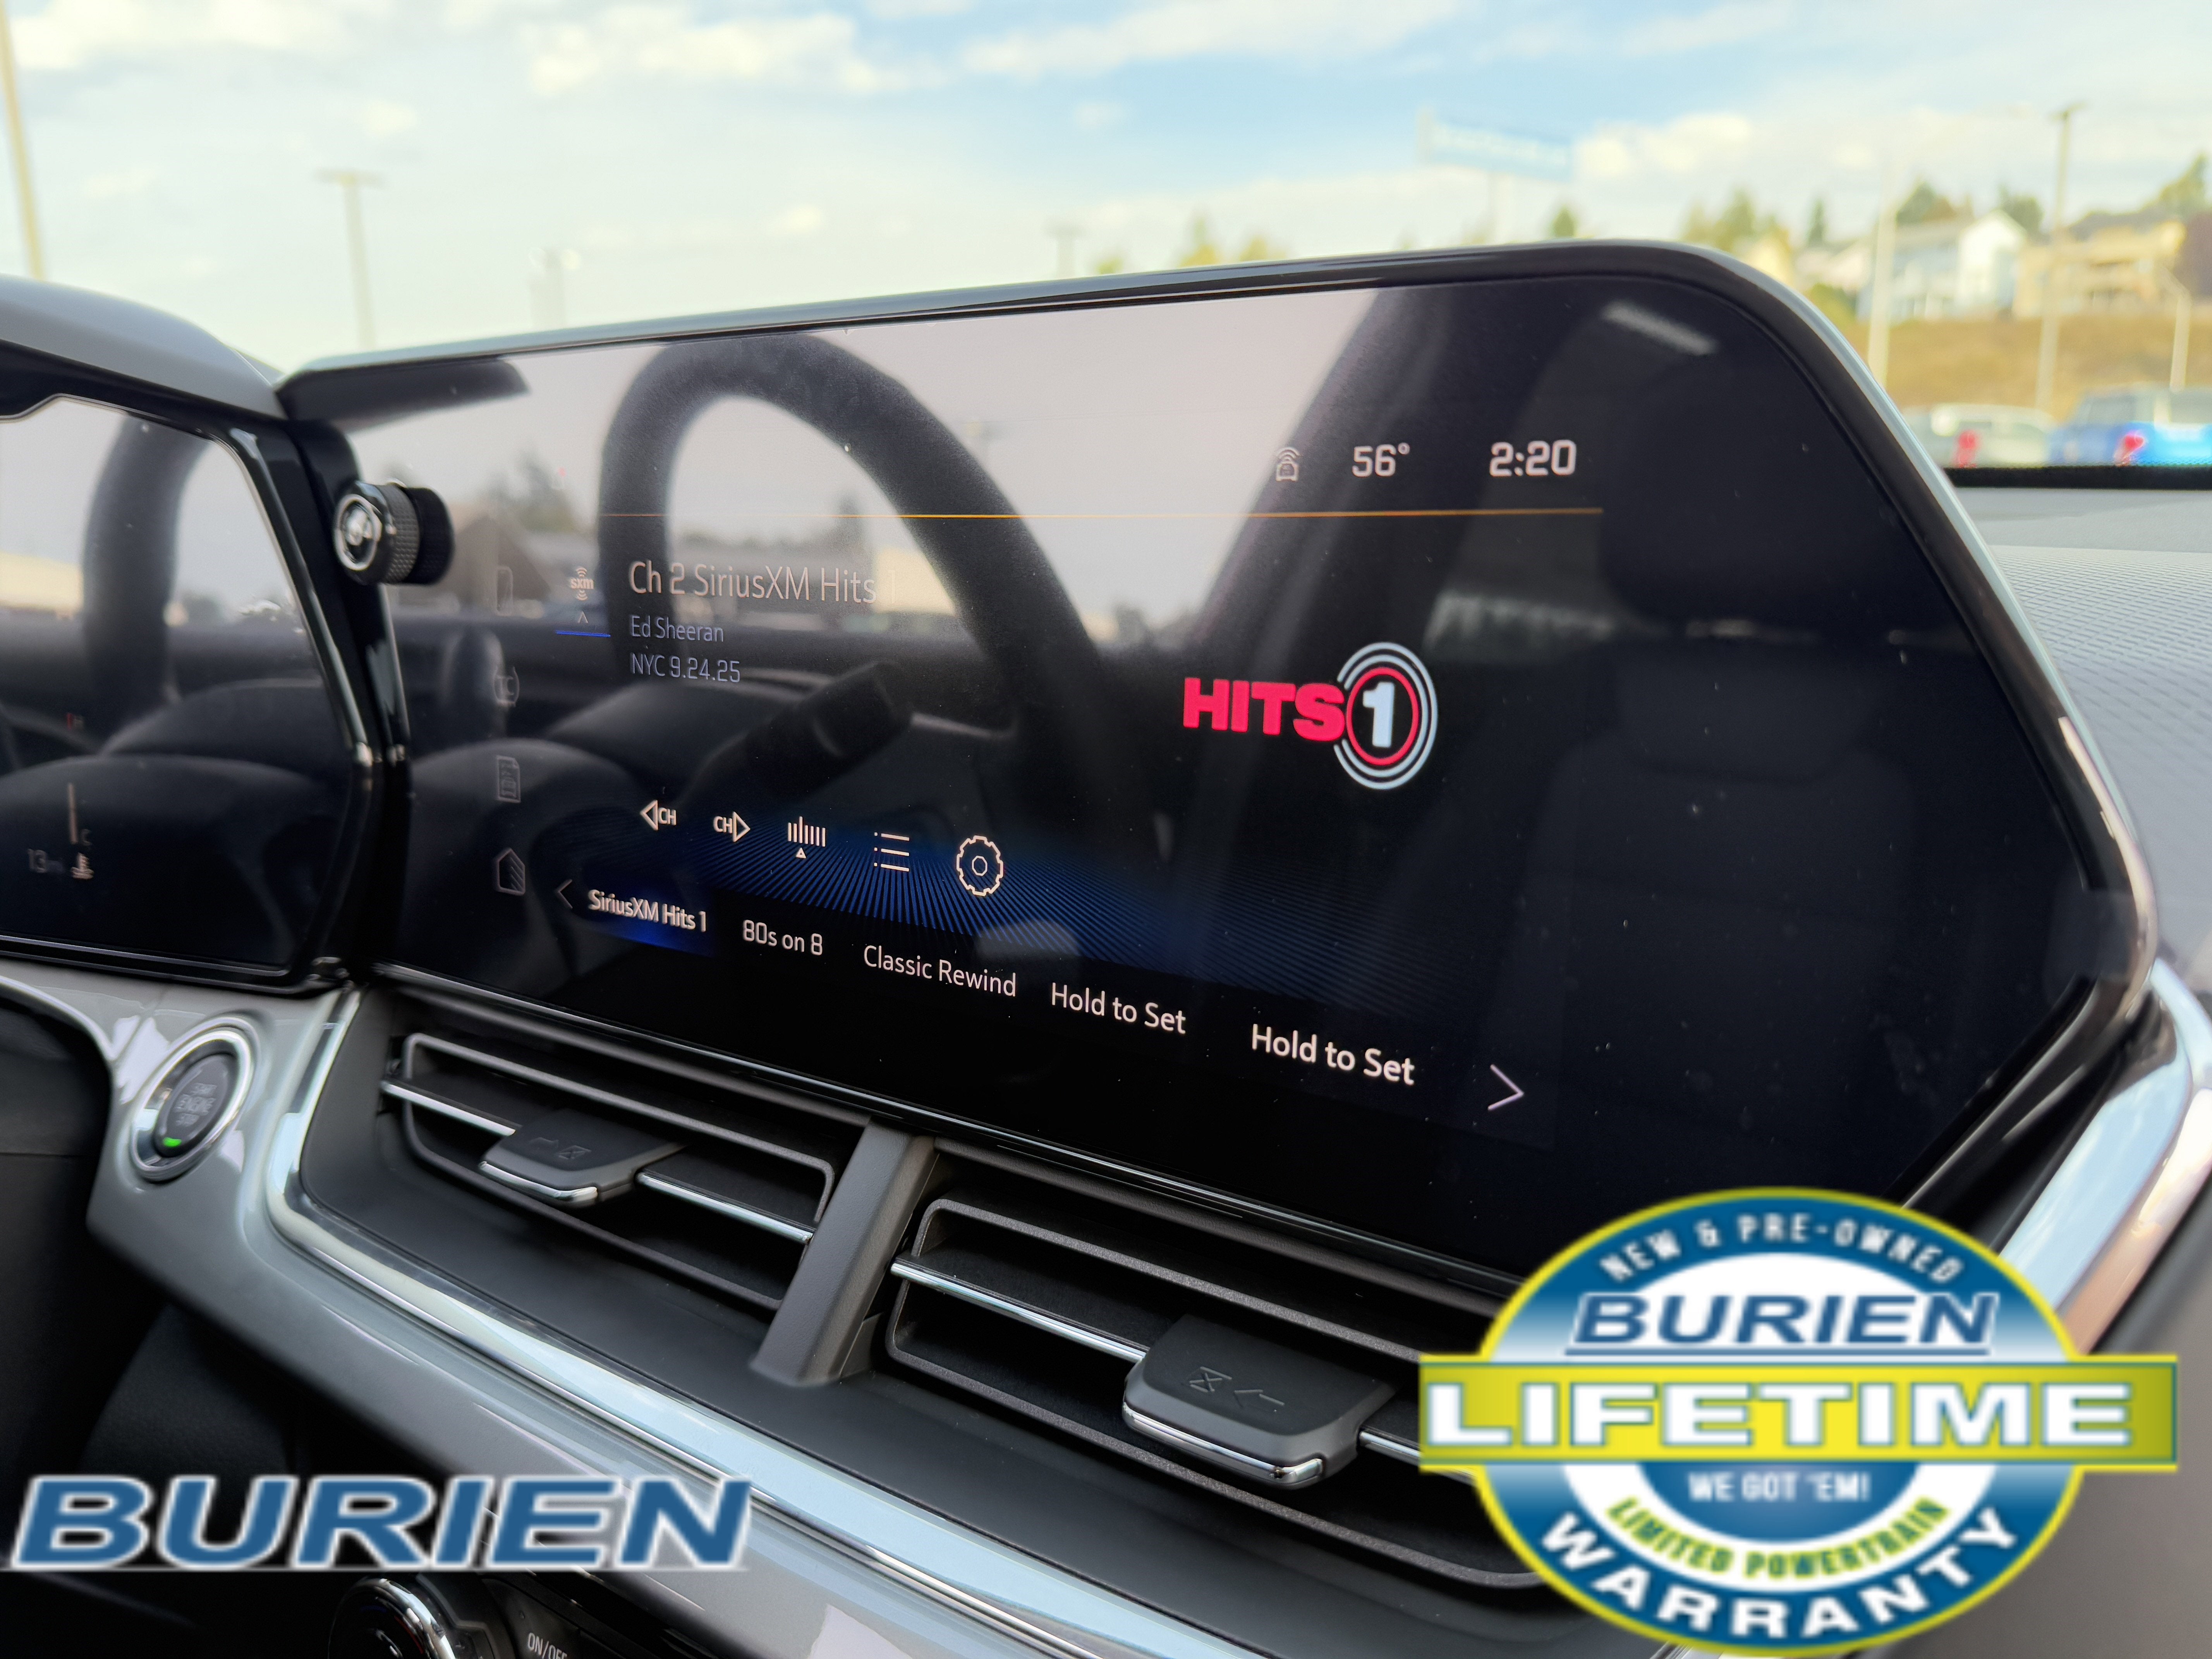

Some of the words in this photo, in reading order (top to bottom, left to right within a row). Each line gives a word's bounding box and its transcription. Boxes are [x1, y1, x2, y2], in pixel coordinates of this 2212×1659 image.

[1489, 440, 1577, 476] 2:20
[570, 578, 594, 589] sxm
[629, 560, 662, 594] Ch
[670, 563, 685, 594] 2
[694, 564, 809, 601] SiriusXM
[821, 567, 877, 603] Hits
[631, 615, 651, 637] Ed
[656, 617, 724, 642] Sheeran
[632, 653, 666, 677] NYC
[670, 656, 740, 683] 9.24.25
[1183, 677, 1345, 741] HITS
[1363, 682, 1394, 748] 1
[659, 807, 677, 826] CH
[713, 816, 733, 834] CH
[588, 890, 658, 922] SiriusXM
[662, 903, 696, 930] Hits
[700, 910, 706, 932] 1
[743, 920, 776, 947] 80s
[781, 935, 804, 953] on
[811, 934, 823, 956] 8
[864, 945, 933, 979] Classic
[939, 959, 1017, 997] Rewind
[1051, 982, 1106, 1016] Hold
[1112, 997, 1137, 1023] to
[1145, 1002, 1187, 1034] Set
[1252, 1024, 1317, 1063] Hold
[1325, 1042, 1355, 1071] to
[1364, 1048, 1415, 1085] Set
